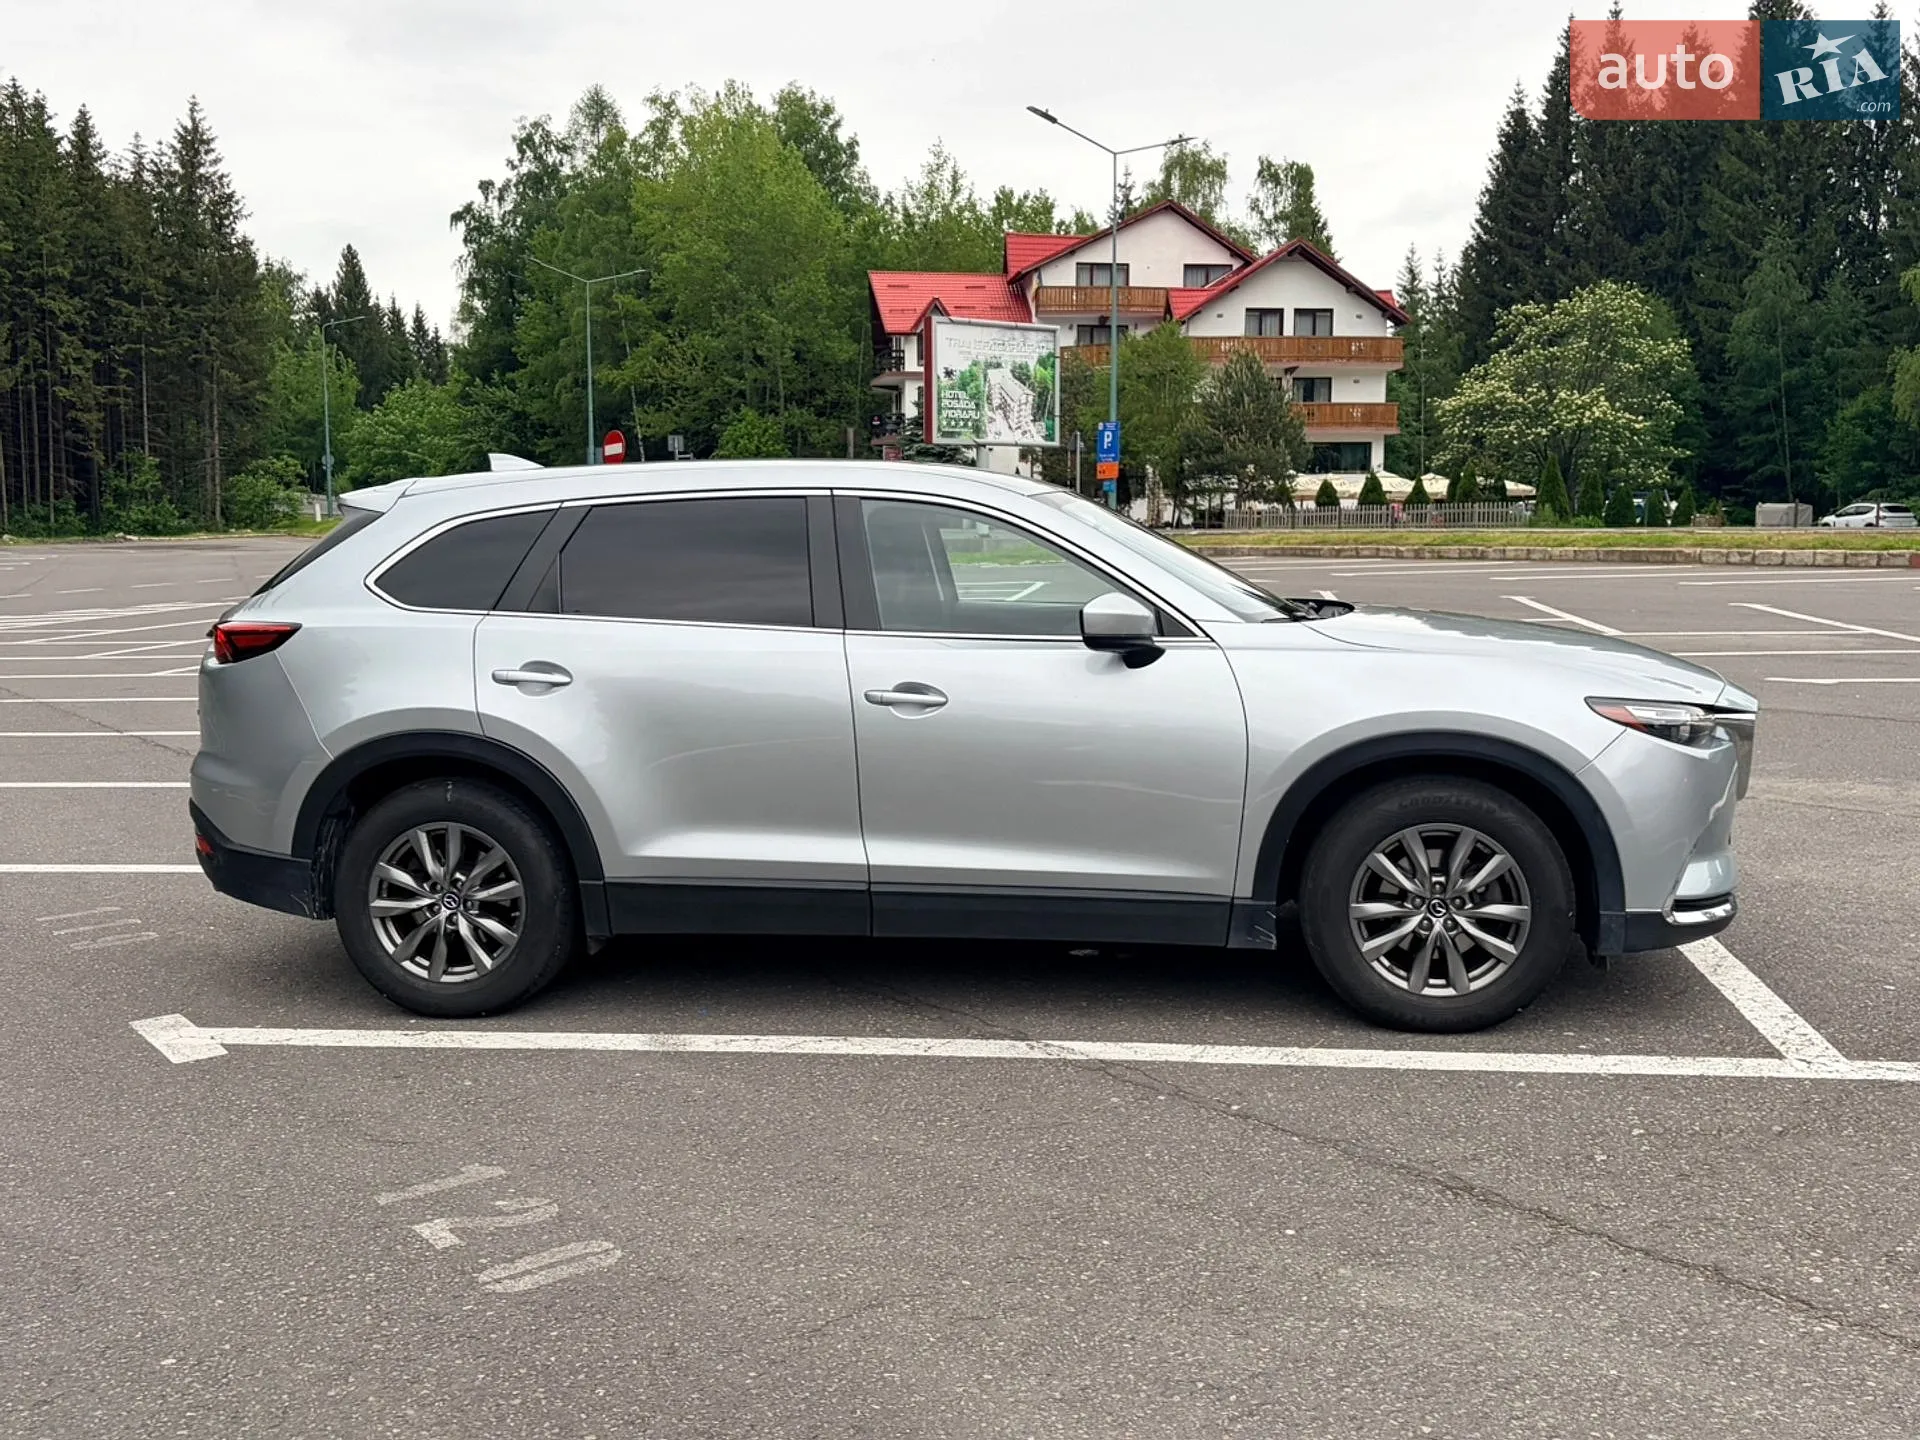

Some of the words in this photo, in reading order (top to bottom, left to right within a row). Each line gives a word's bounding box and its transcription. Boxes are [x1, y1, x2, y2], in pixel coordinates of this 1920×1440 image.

[941, 390, 969, 400] HOTEL
[941, 399, 976, 409] POSADA
[941, 409, 980, 419] VIDRARU
[1103, 431, 1113, 450] P
[374, 1165, 622, 1293] 120
